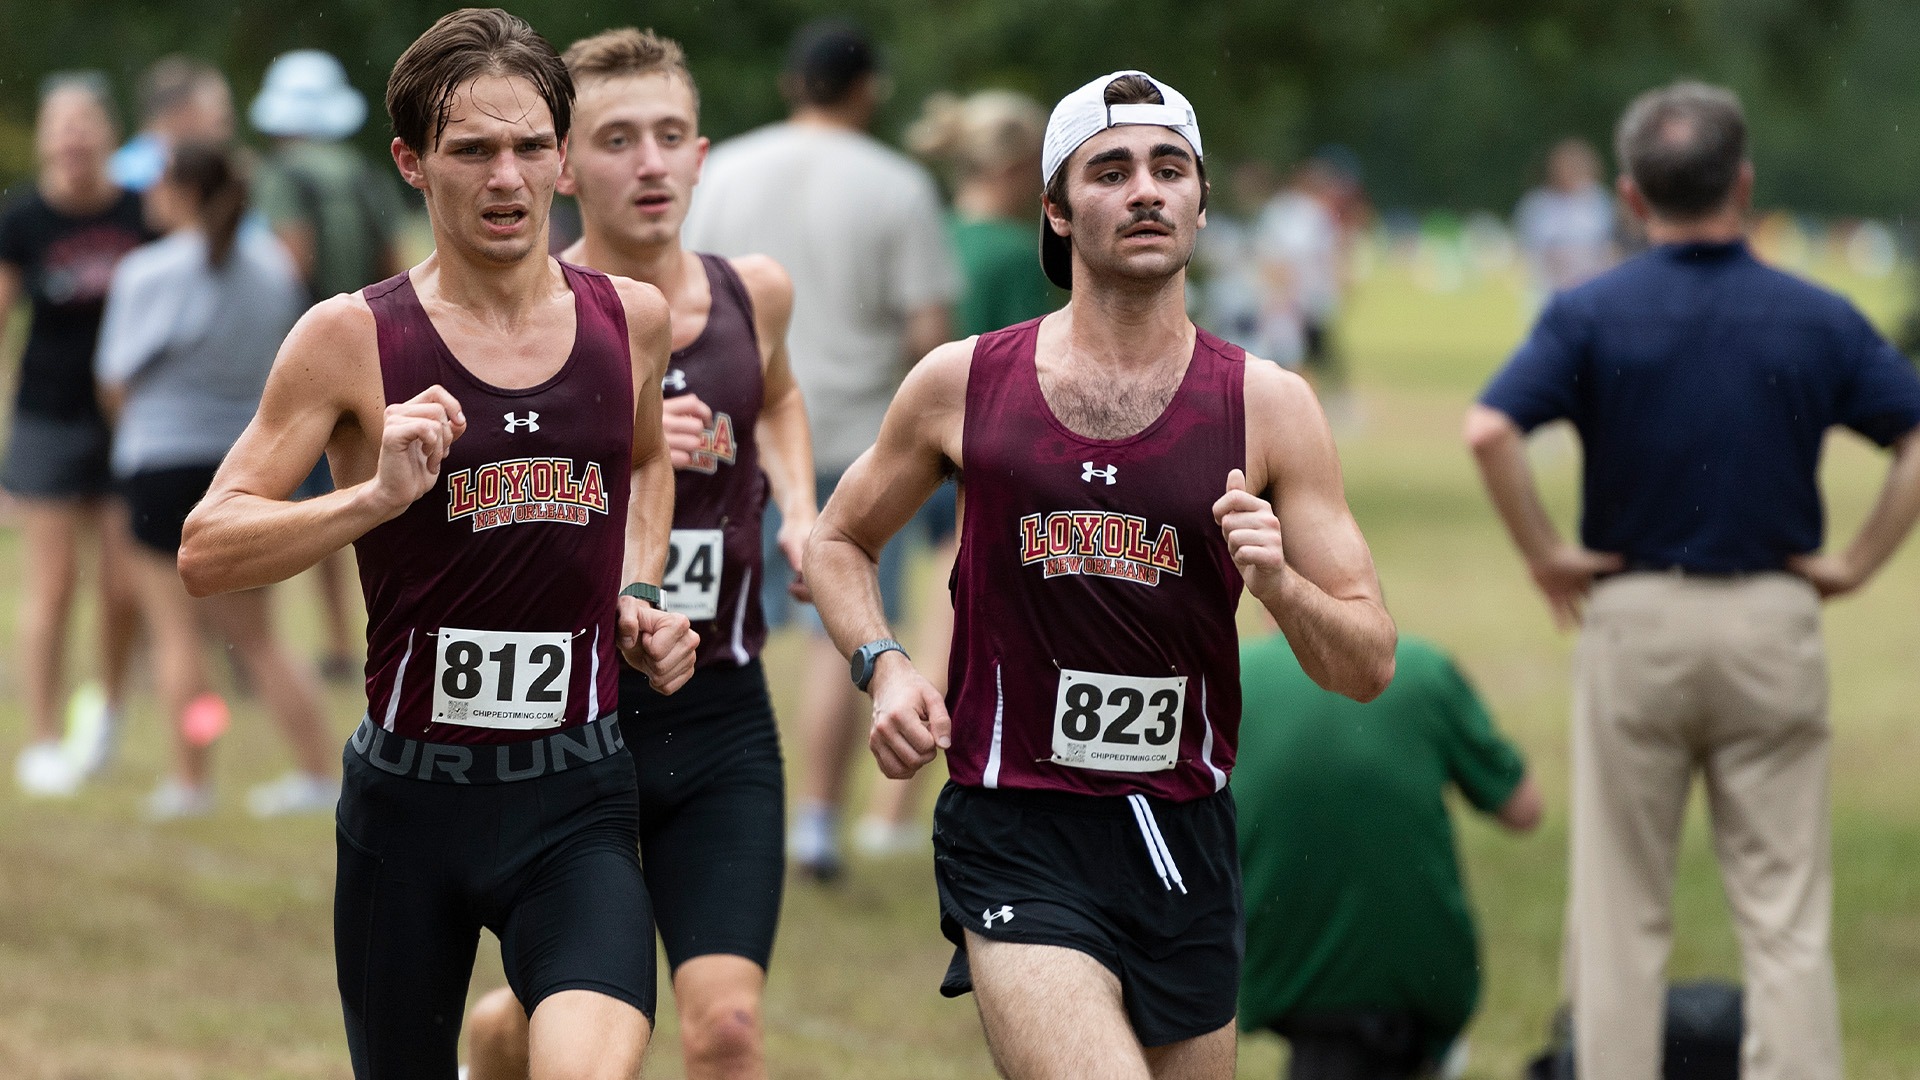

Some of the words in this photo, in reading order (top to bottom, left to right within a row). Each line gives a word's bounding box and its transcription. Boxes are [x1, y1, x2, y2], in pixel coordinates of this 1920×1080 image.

[449, 458, 607, 520] LOYOLA
[475, 506, 513, 529] NEW
[515, 504, 588, 524] ORLEANS
[1021, 512, 1183, 575] LOYOLA
[1046, 557, 1082, 576] NEW
[1083, 557, 1158, 585] ORLEANS
[442, 641, 565, 702] 812
[473, 710, 554, 720] CHIPPEDTIMING.COM
[1062, 683, 1178, 746] 823
[1091, 752, 1167, 762] CHIPPEDTIMING.COM
